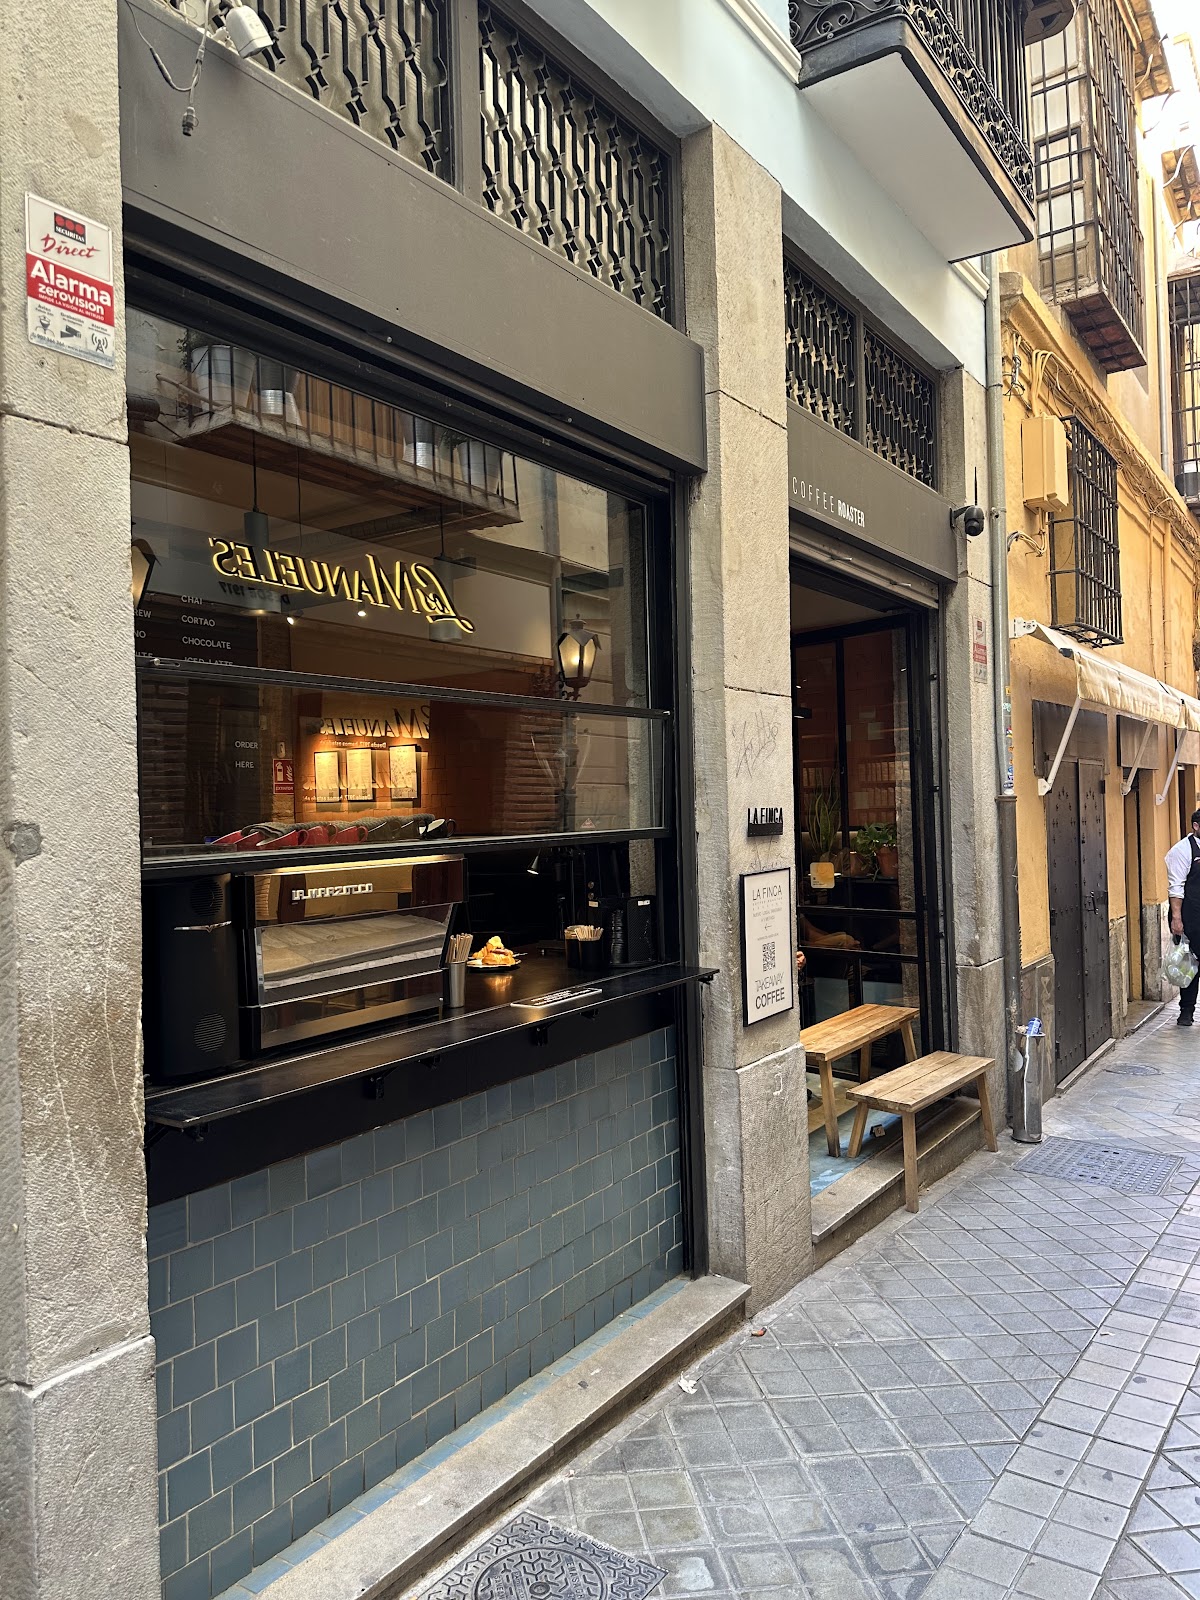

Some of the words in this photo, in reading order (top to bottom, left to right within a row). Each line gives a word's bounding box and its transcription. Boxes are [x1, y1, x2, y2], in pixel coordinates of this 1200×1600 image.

[55, 226, 85, 242] SECURITAS
[40, 233, 101, 258] Direct
[30, 259, 112, 307] Alarma
[792, 476, 834, 514] COFFEE
[837, 499, 865, 528] ROASTER
[181, 594, 203, 605] CHAI
[181, 614, 216, 627] CORTAO
[182, 636, 232, 650] CHOCOLATE
[234, 740, 258, 749] ORDER
[235, 760, 254, 768] HERE
[748, 808, 758, 824] LA
[760, 808, 784, 824] FINCA
[752, 889, 761, 900] LA
[762, 884, 782, 899] FINCA
[756, 986, 785, 1010] COFFEE
